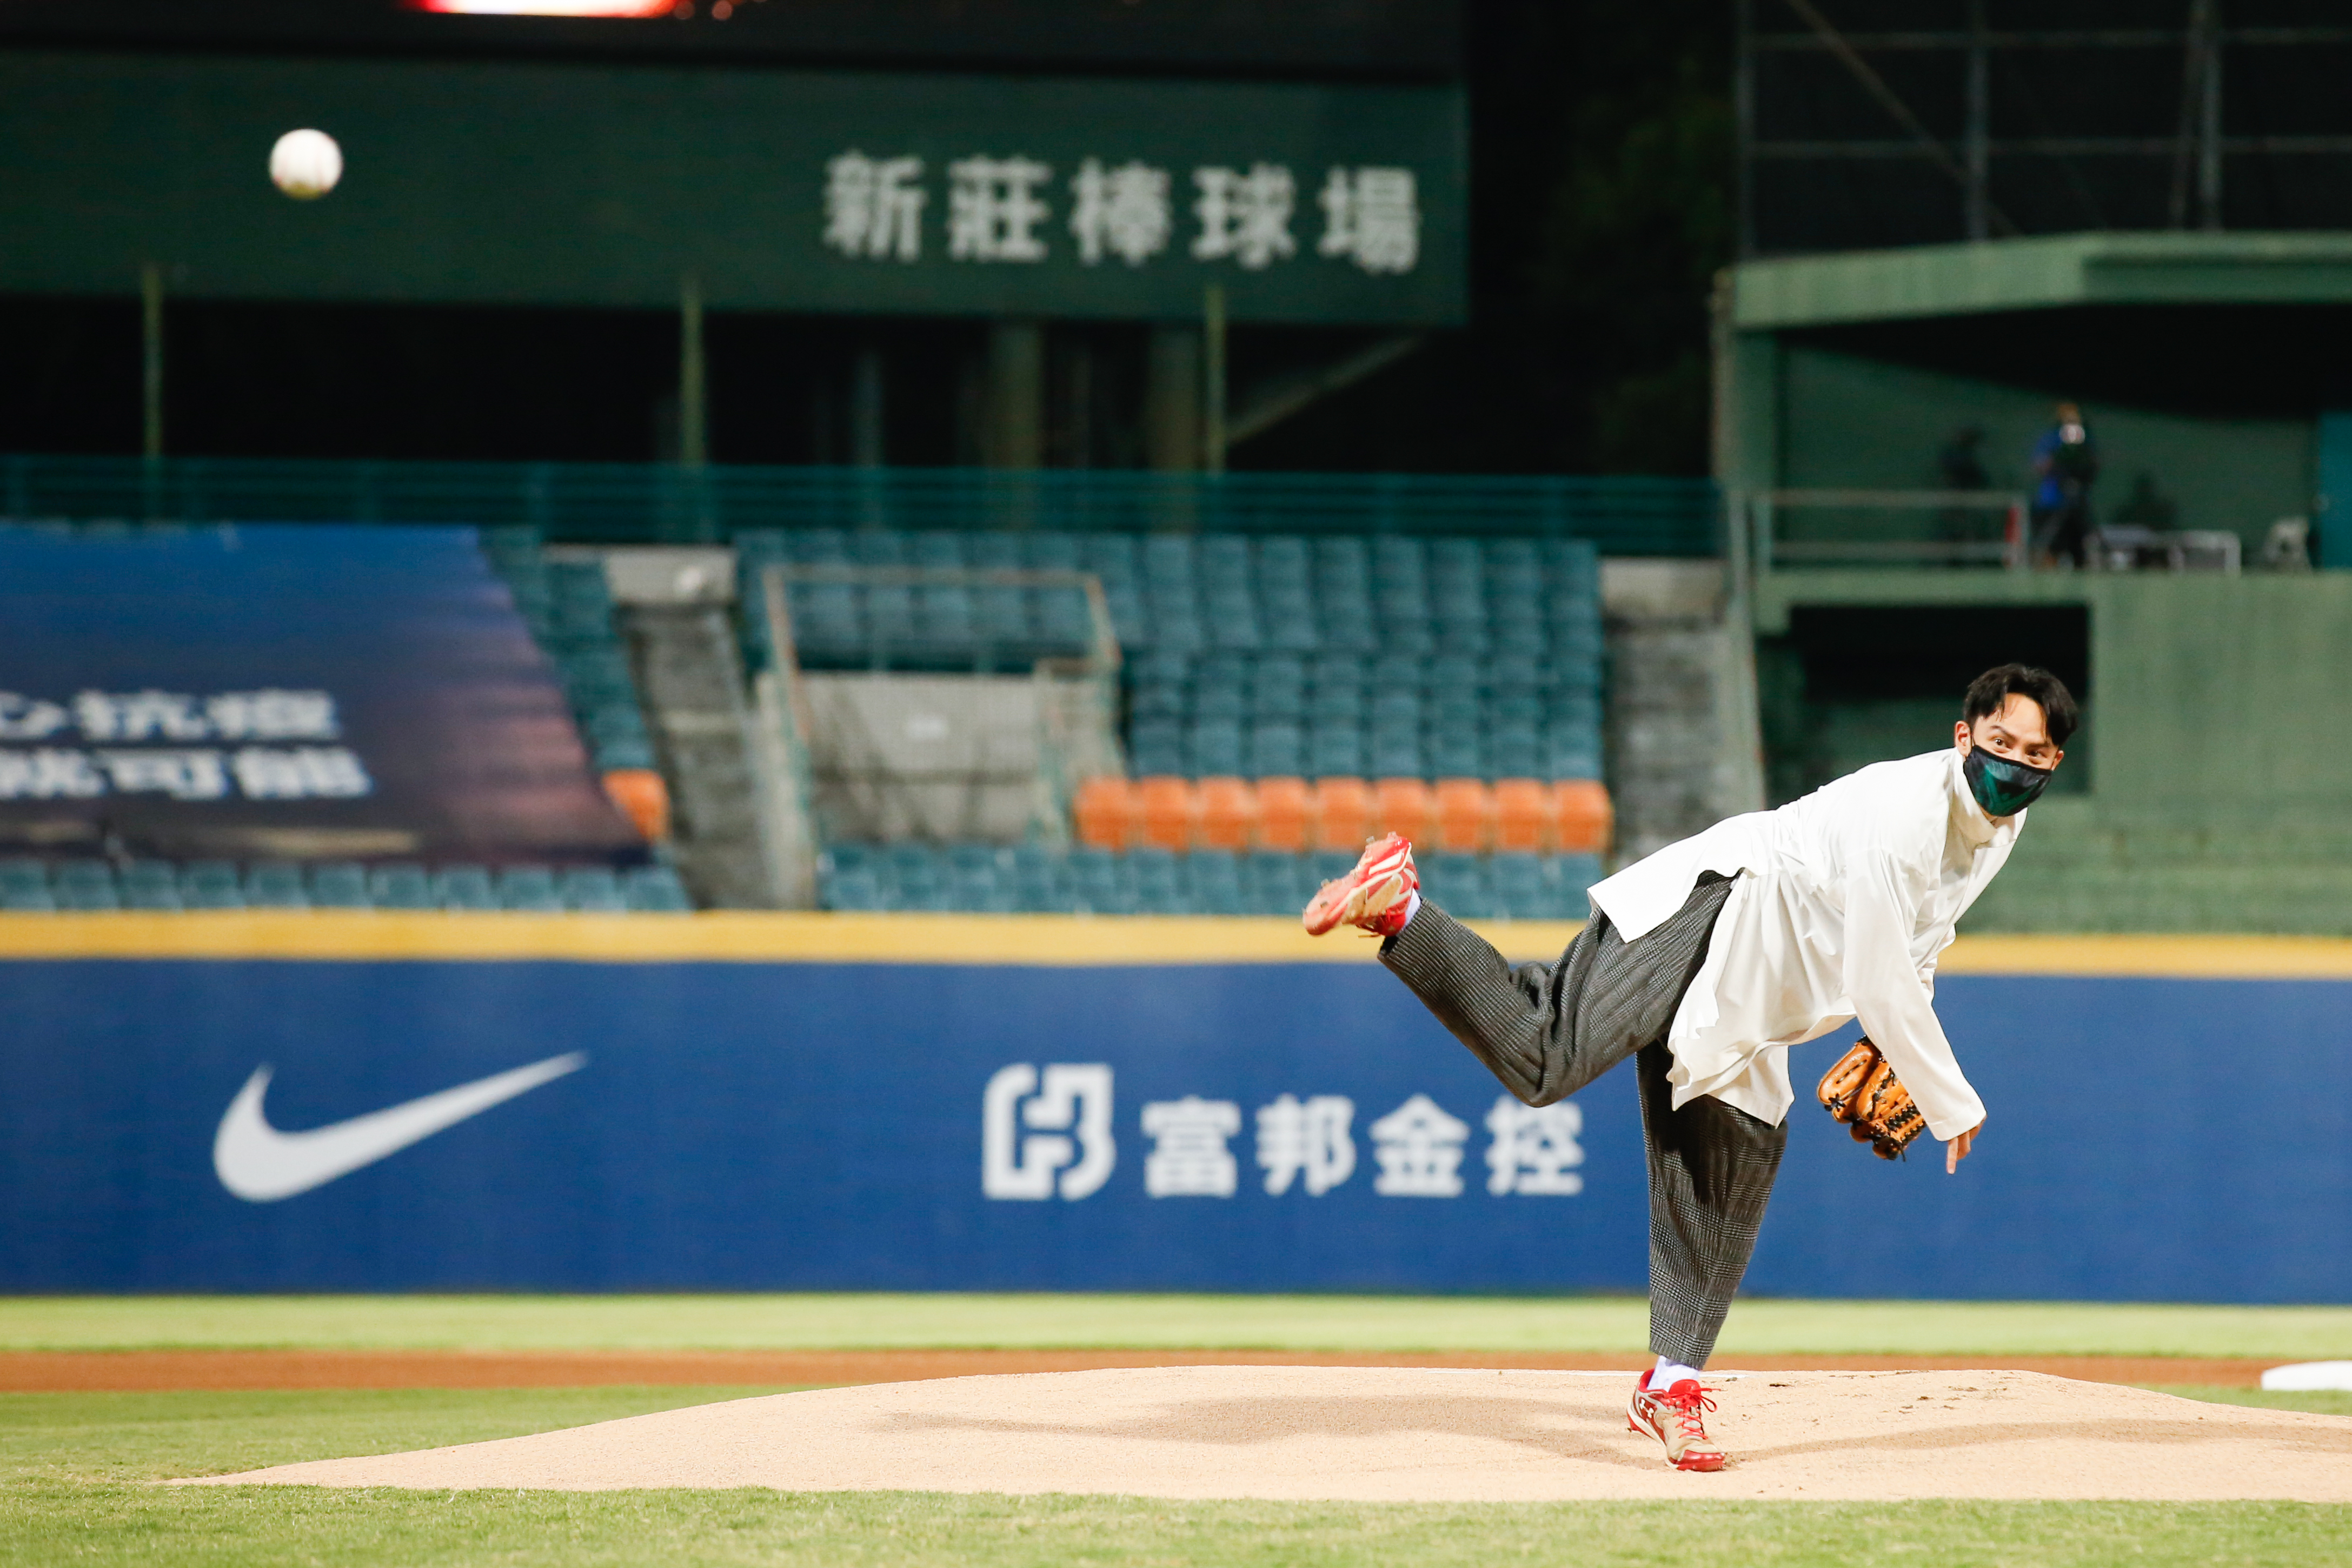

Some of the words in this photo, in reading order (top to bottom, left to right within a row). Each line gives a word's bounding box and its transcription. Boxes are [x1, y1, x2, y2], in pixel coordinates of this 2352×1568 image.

[823, 151, 1419, 272] 新莊棒球場
[1141, 1093, 1584, 1197] 富邦金控
